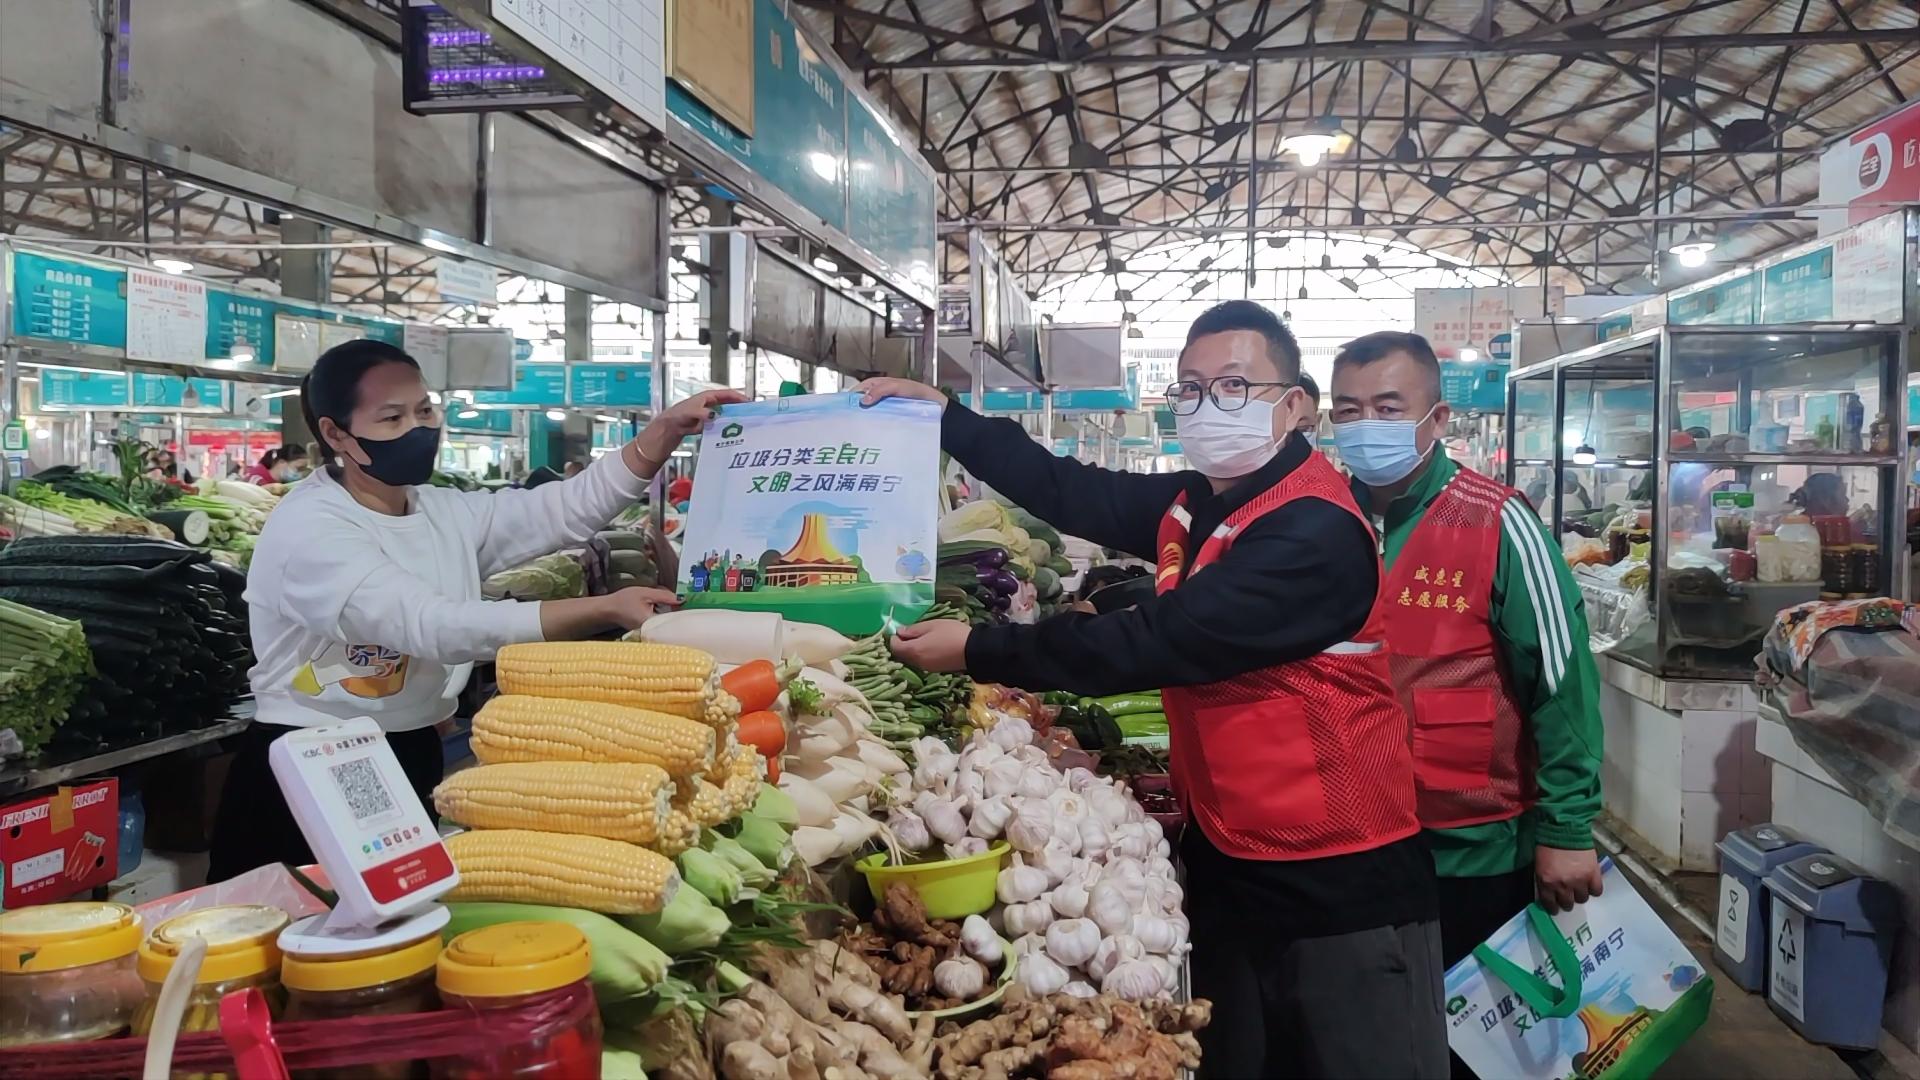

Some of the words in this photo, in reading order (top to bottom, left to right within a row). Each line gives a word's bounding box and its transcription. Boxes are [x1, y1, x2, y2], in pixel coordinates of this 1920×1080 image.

[728, 443, 881, 469] 垃圾分类全民行
[747, 471, 903, 494] 文明之风满南宁
[1398, 586, 1471, 614] 志愿服务
[1, 803, 49, 828] FRESH
[73, 787, 108, 809] RROT
